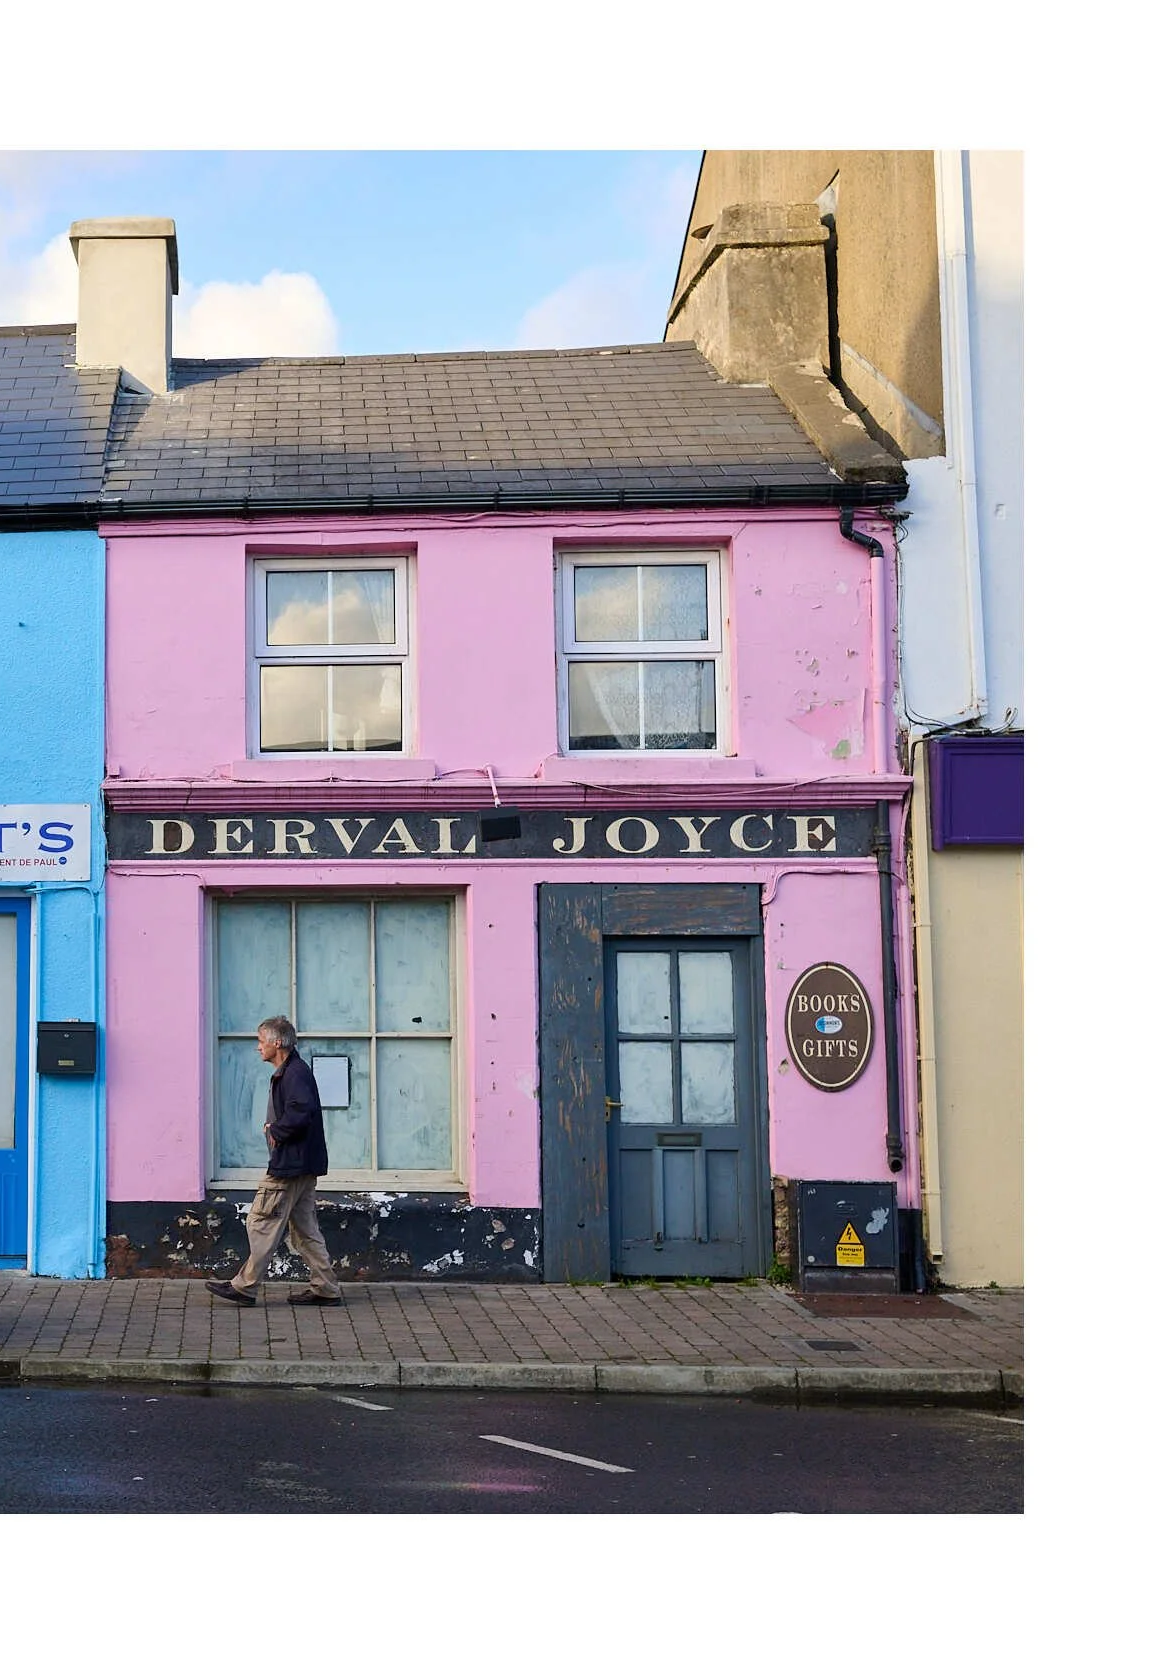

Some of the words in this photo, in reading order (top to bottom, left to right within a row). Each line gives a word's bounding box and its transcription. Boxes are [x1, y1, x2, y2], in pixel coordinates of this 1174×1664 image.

[145, 817, 477, 856] DERVAL
[552, 813, 837, 855] JOYCE
[19, 858, 32, 867] DE
[34, 858, 58, 867] PAUL
[797, 994, 861, 1013] BOOKS
[802, 1038, 858, 1058] GIFTS
